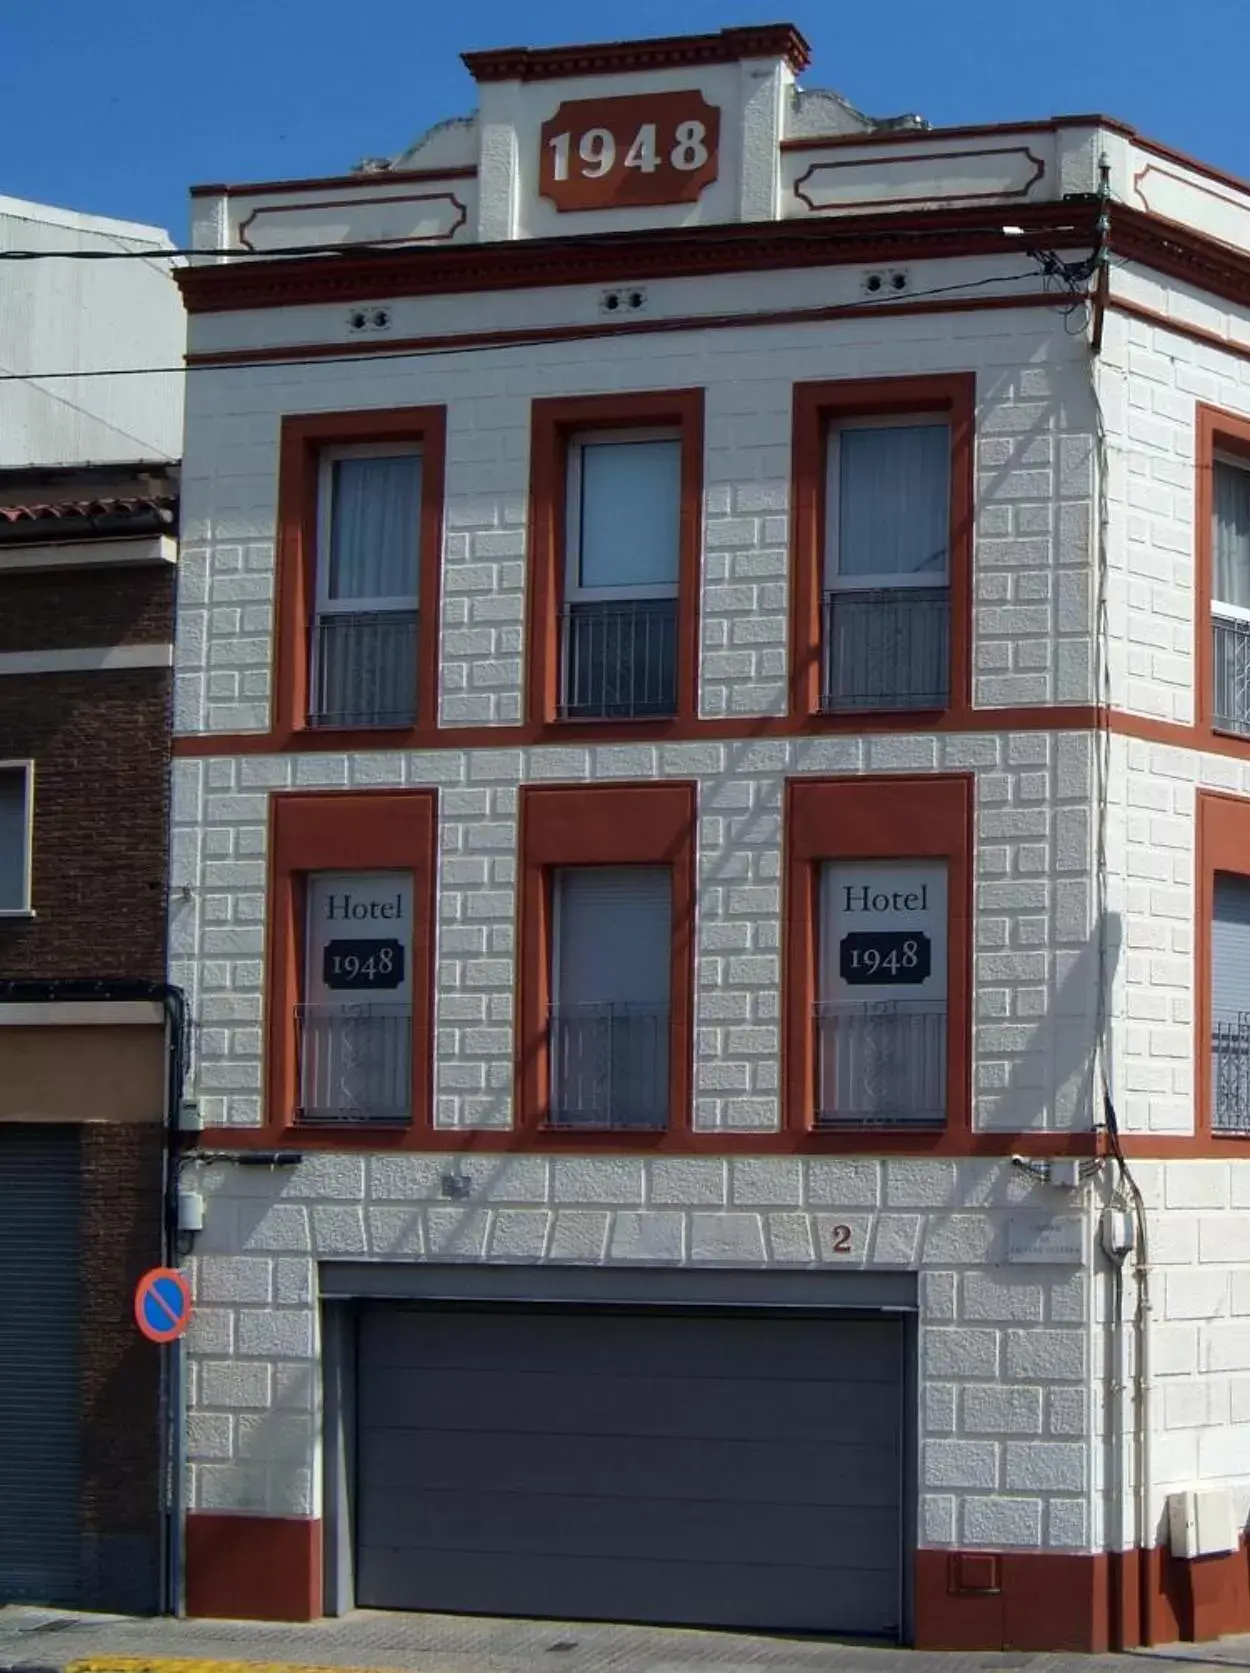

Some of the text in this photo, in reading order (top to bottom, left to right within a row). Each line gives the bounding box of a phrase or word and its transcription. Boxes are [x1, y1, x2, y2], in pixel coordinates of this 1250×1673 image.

[549, 120, 708, 181] 1948
[326, 894, 404, 920] Hotel
[842, 884, 928, 912] Hotel
[332, 947, 393, 980] 1948
[851, 940, 918, 975] 1948
[832, 1224, 851, 1253] 2
